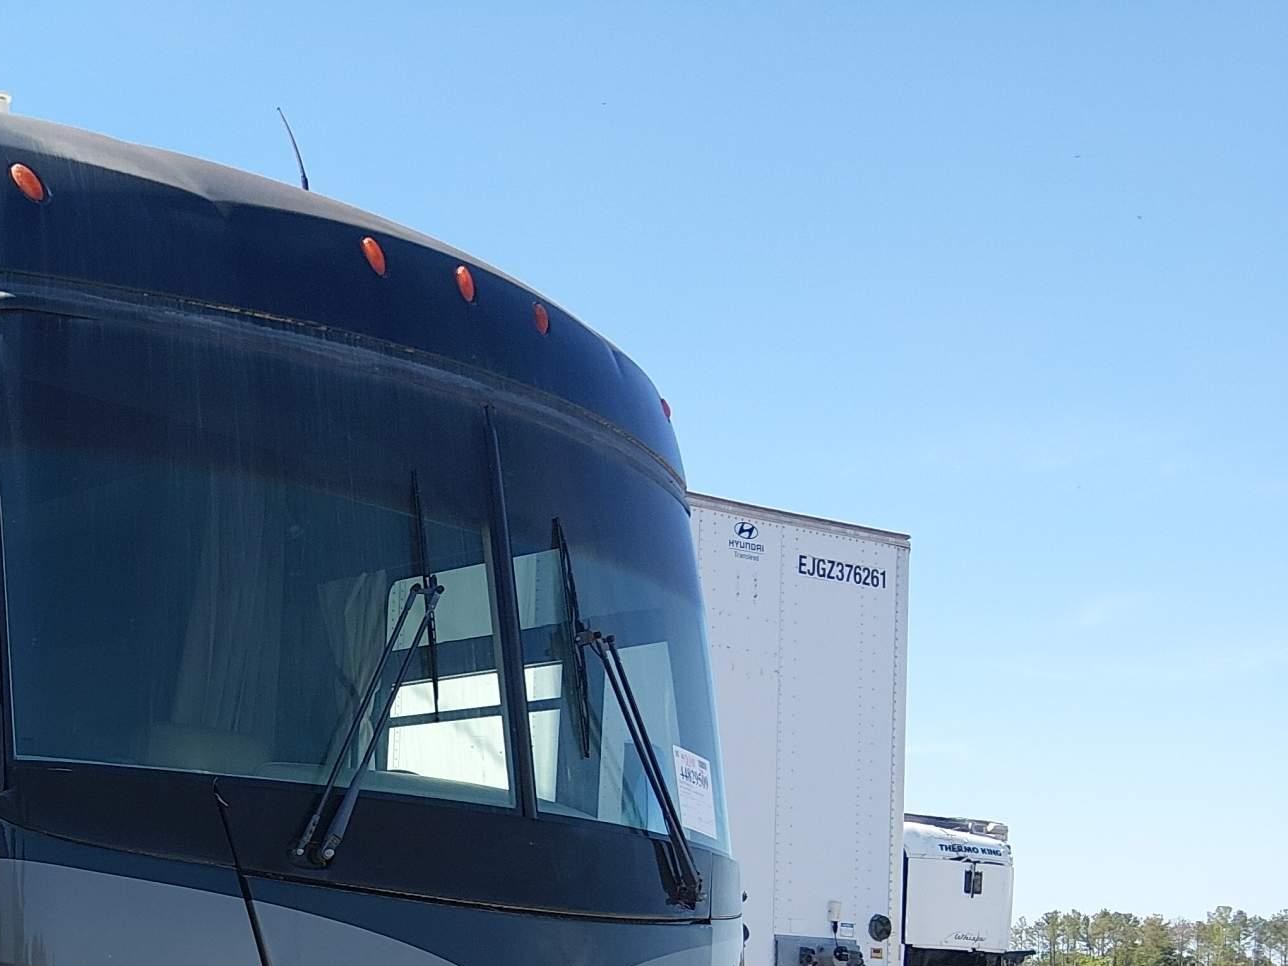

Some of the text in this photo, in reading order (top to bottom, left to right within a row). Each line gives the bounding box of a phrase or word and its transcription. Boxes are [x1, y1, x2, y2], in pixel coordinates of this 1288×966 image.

[728, 539, 765, 553] HYUNDAI
[798, 554, 887, 589] EJGZ376261
[938, 843, 1002, 857] THERMO KING
